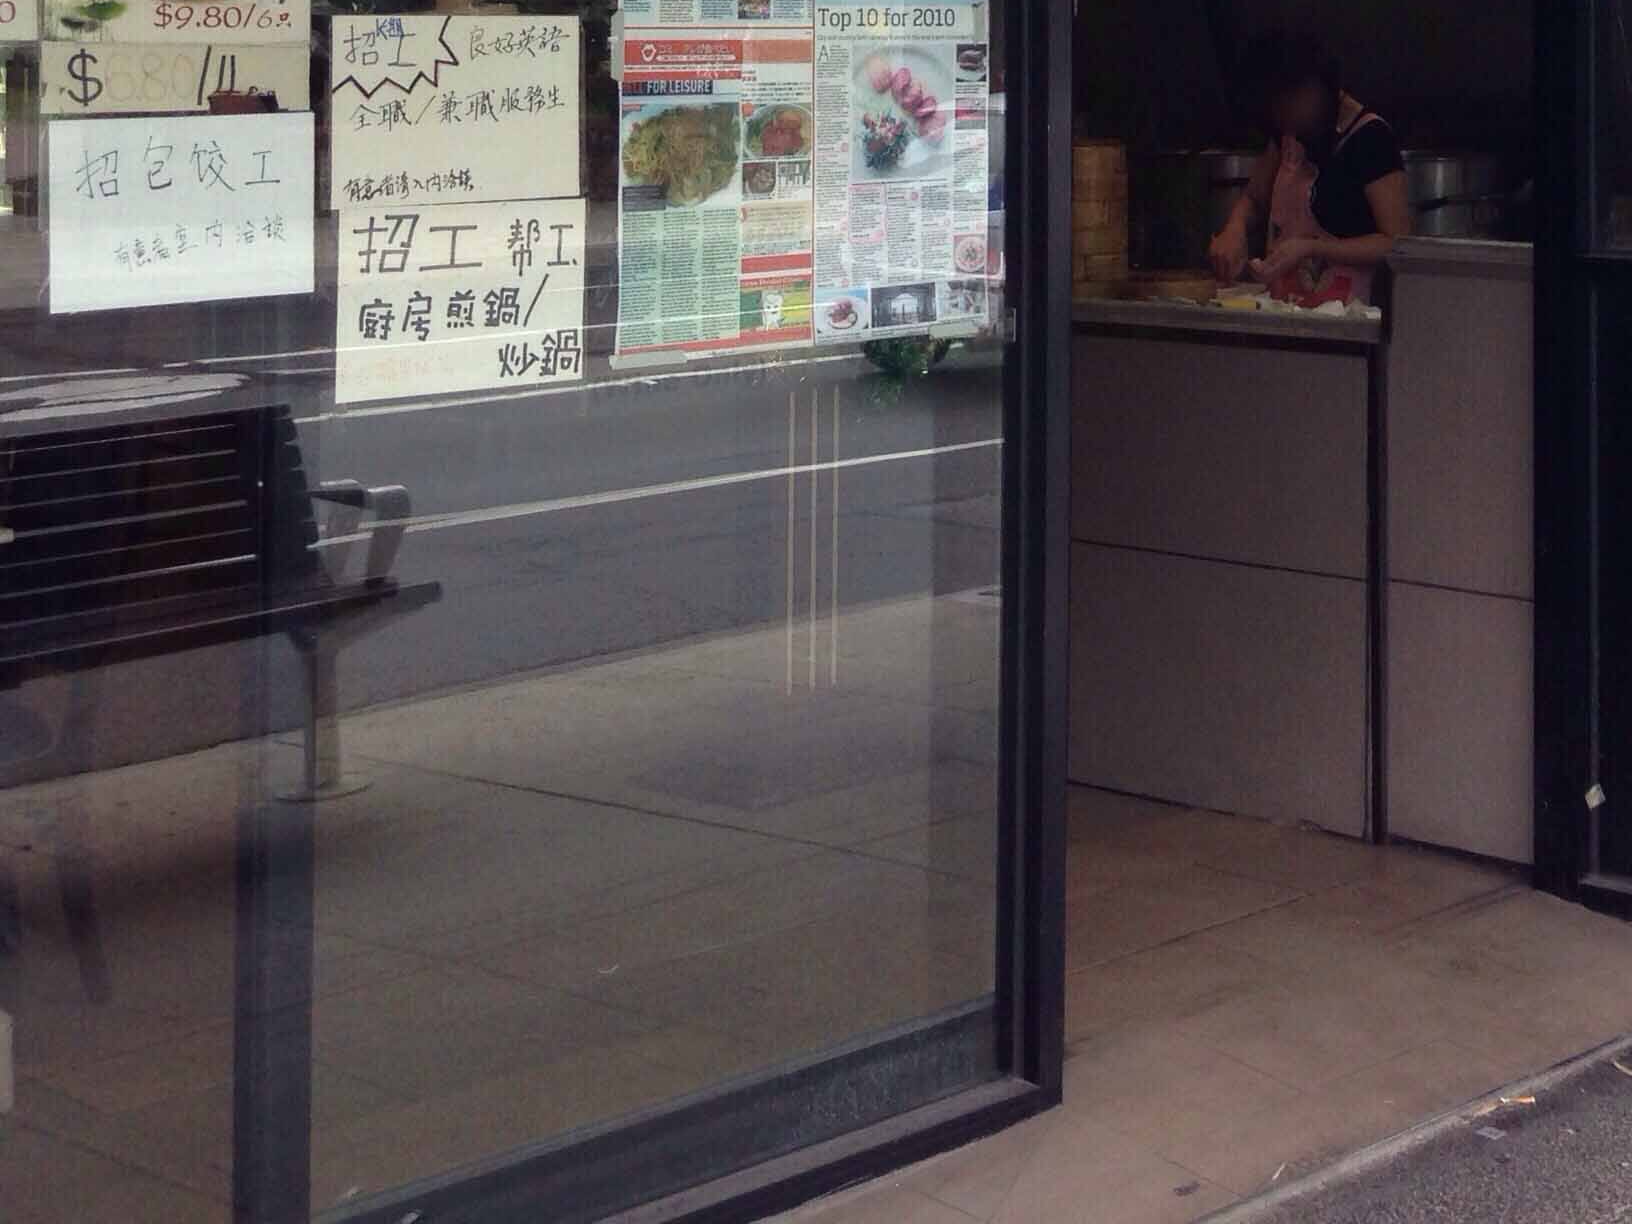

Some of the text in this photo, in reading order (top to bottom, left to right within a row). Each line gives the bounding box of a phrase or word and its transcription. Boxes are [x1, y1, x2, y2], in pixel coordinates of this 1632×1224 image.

[818, 7, 956, 31] Top 10 for 2010
[646, 80, 669, 94] FOR
[670, 79, 712, 94] LEISURE
[353, 213, 483, 273] 招工
